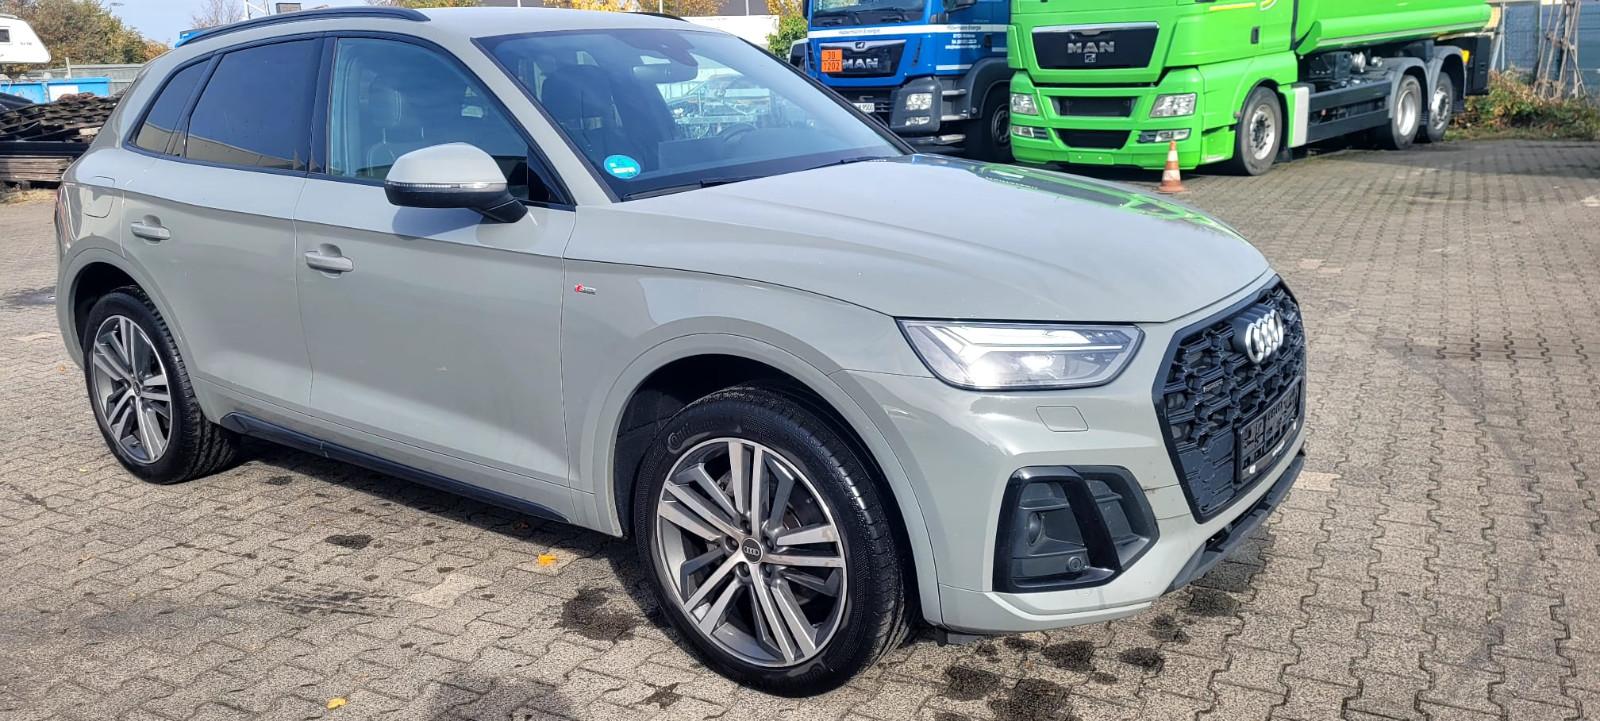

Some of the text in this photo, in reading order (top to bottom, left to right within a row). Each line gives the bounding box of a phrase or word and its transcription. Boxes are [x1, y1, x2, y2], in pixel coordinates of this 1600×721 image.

[1067, 41, 1115, 54] MAN
[823, 62, 840, 71] 1202
[842, 57, 879, 69] MAN
